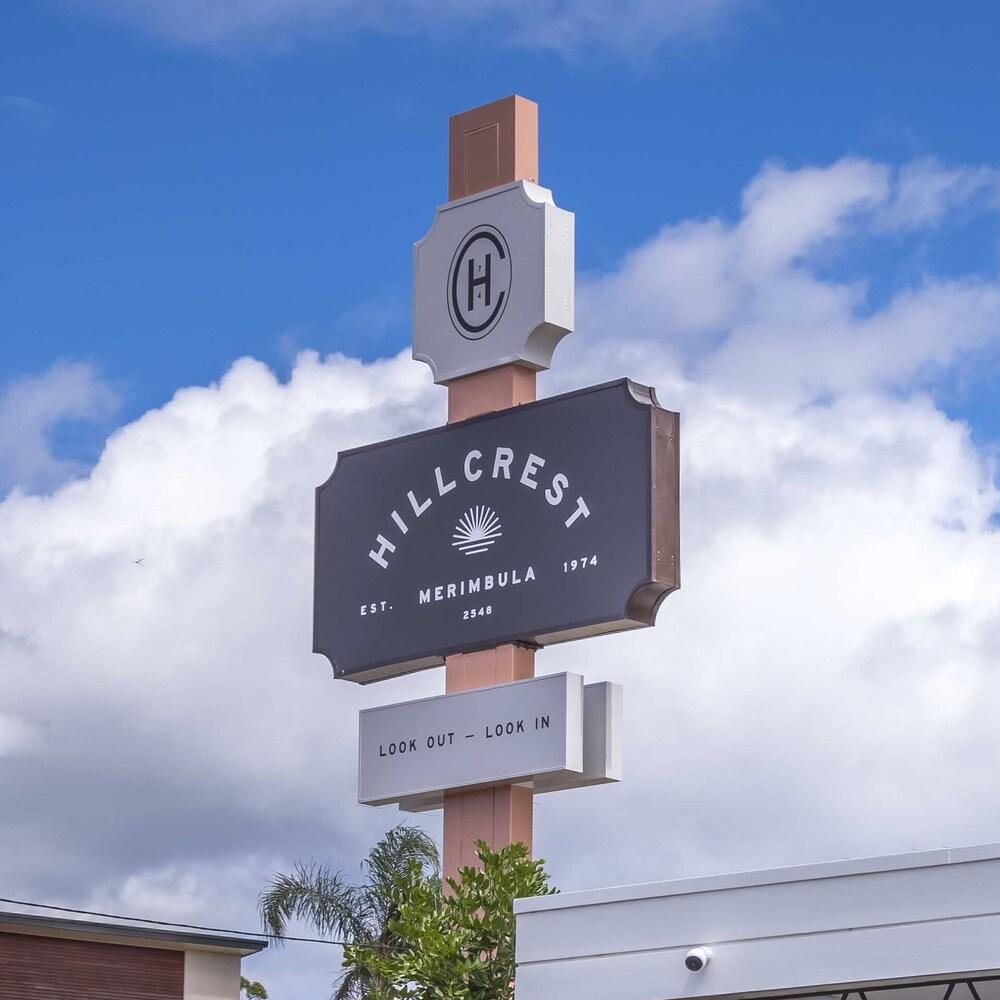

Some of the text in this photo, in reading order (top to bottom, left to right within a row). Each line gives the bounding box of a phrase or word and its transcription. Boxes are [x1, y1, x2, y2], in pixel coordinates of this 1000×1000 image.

[368, 446, 591, 569] HILLCREST
[360, 555, 598, 616] EST. MERIMBULA 1974
[463, 605, 492, 620] 2548
[379, 739, 417, 757] LOOK
[427, 732, 455, 749] OUT
[485, 719, 525, 739] LOOK
[535, 715, 550, 730] IN
